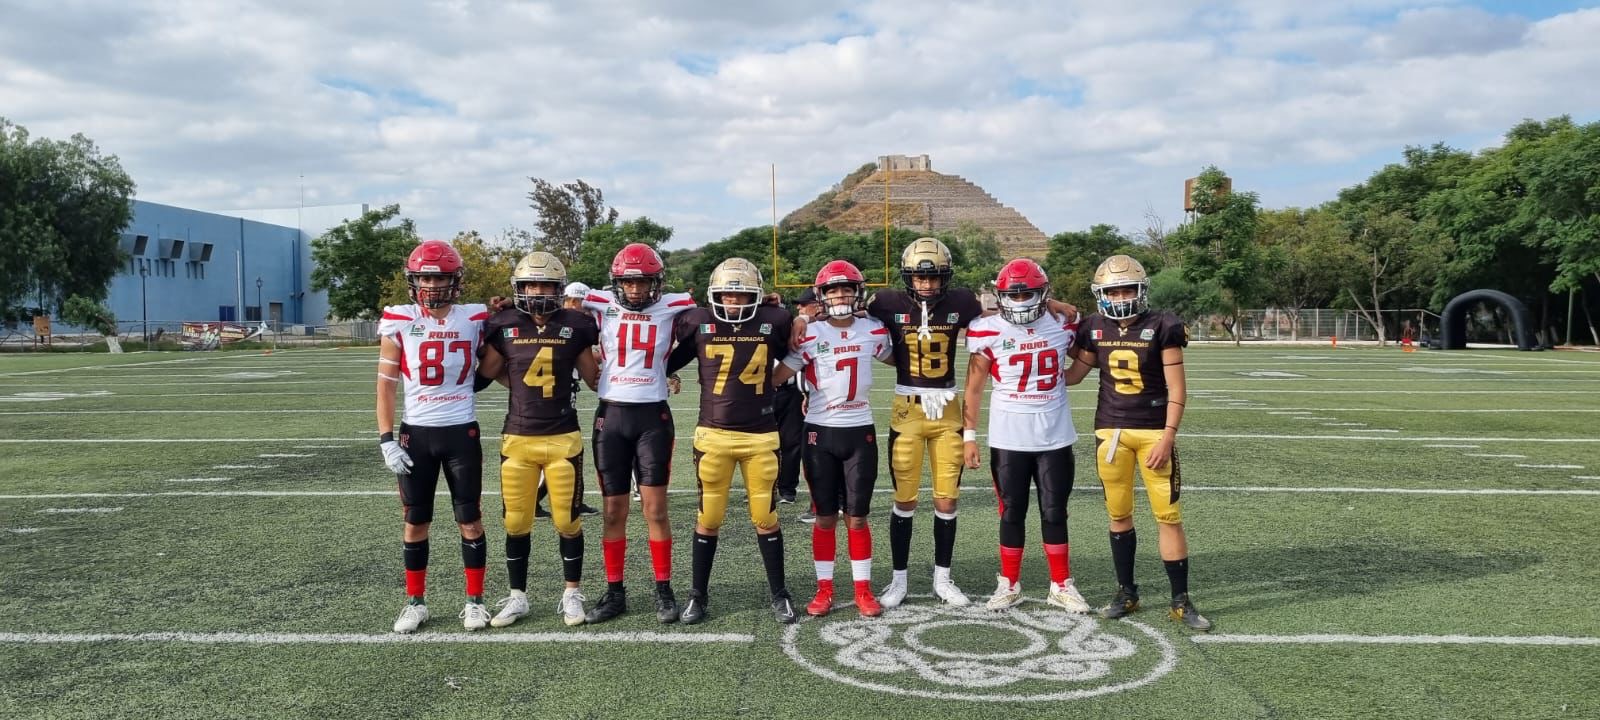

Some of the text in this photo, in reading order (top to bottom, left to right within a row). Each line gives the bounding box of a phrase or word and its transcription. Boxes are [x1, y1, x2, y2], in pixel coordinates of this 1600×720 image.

[428, 331, 459, 339] ROJOS
[622, 313, 652, 321] ROJOS
[841, 331, 848, 339] R
[419, 340, 472, 386] 87
[616, 323, 657, 369] 14
[834, 345, 861, 355] ROJOS
[905, 332, 949, 378] 18
[1020, 341, 1048, 351] ROJOS
[523, 346, 555, 398] 4
[705, 344, 768, 395] 74
[836, 357, 858, 402] 7
[1009, 349, 1059, 392] 79
[1108, 349, 1144, 395] 9
